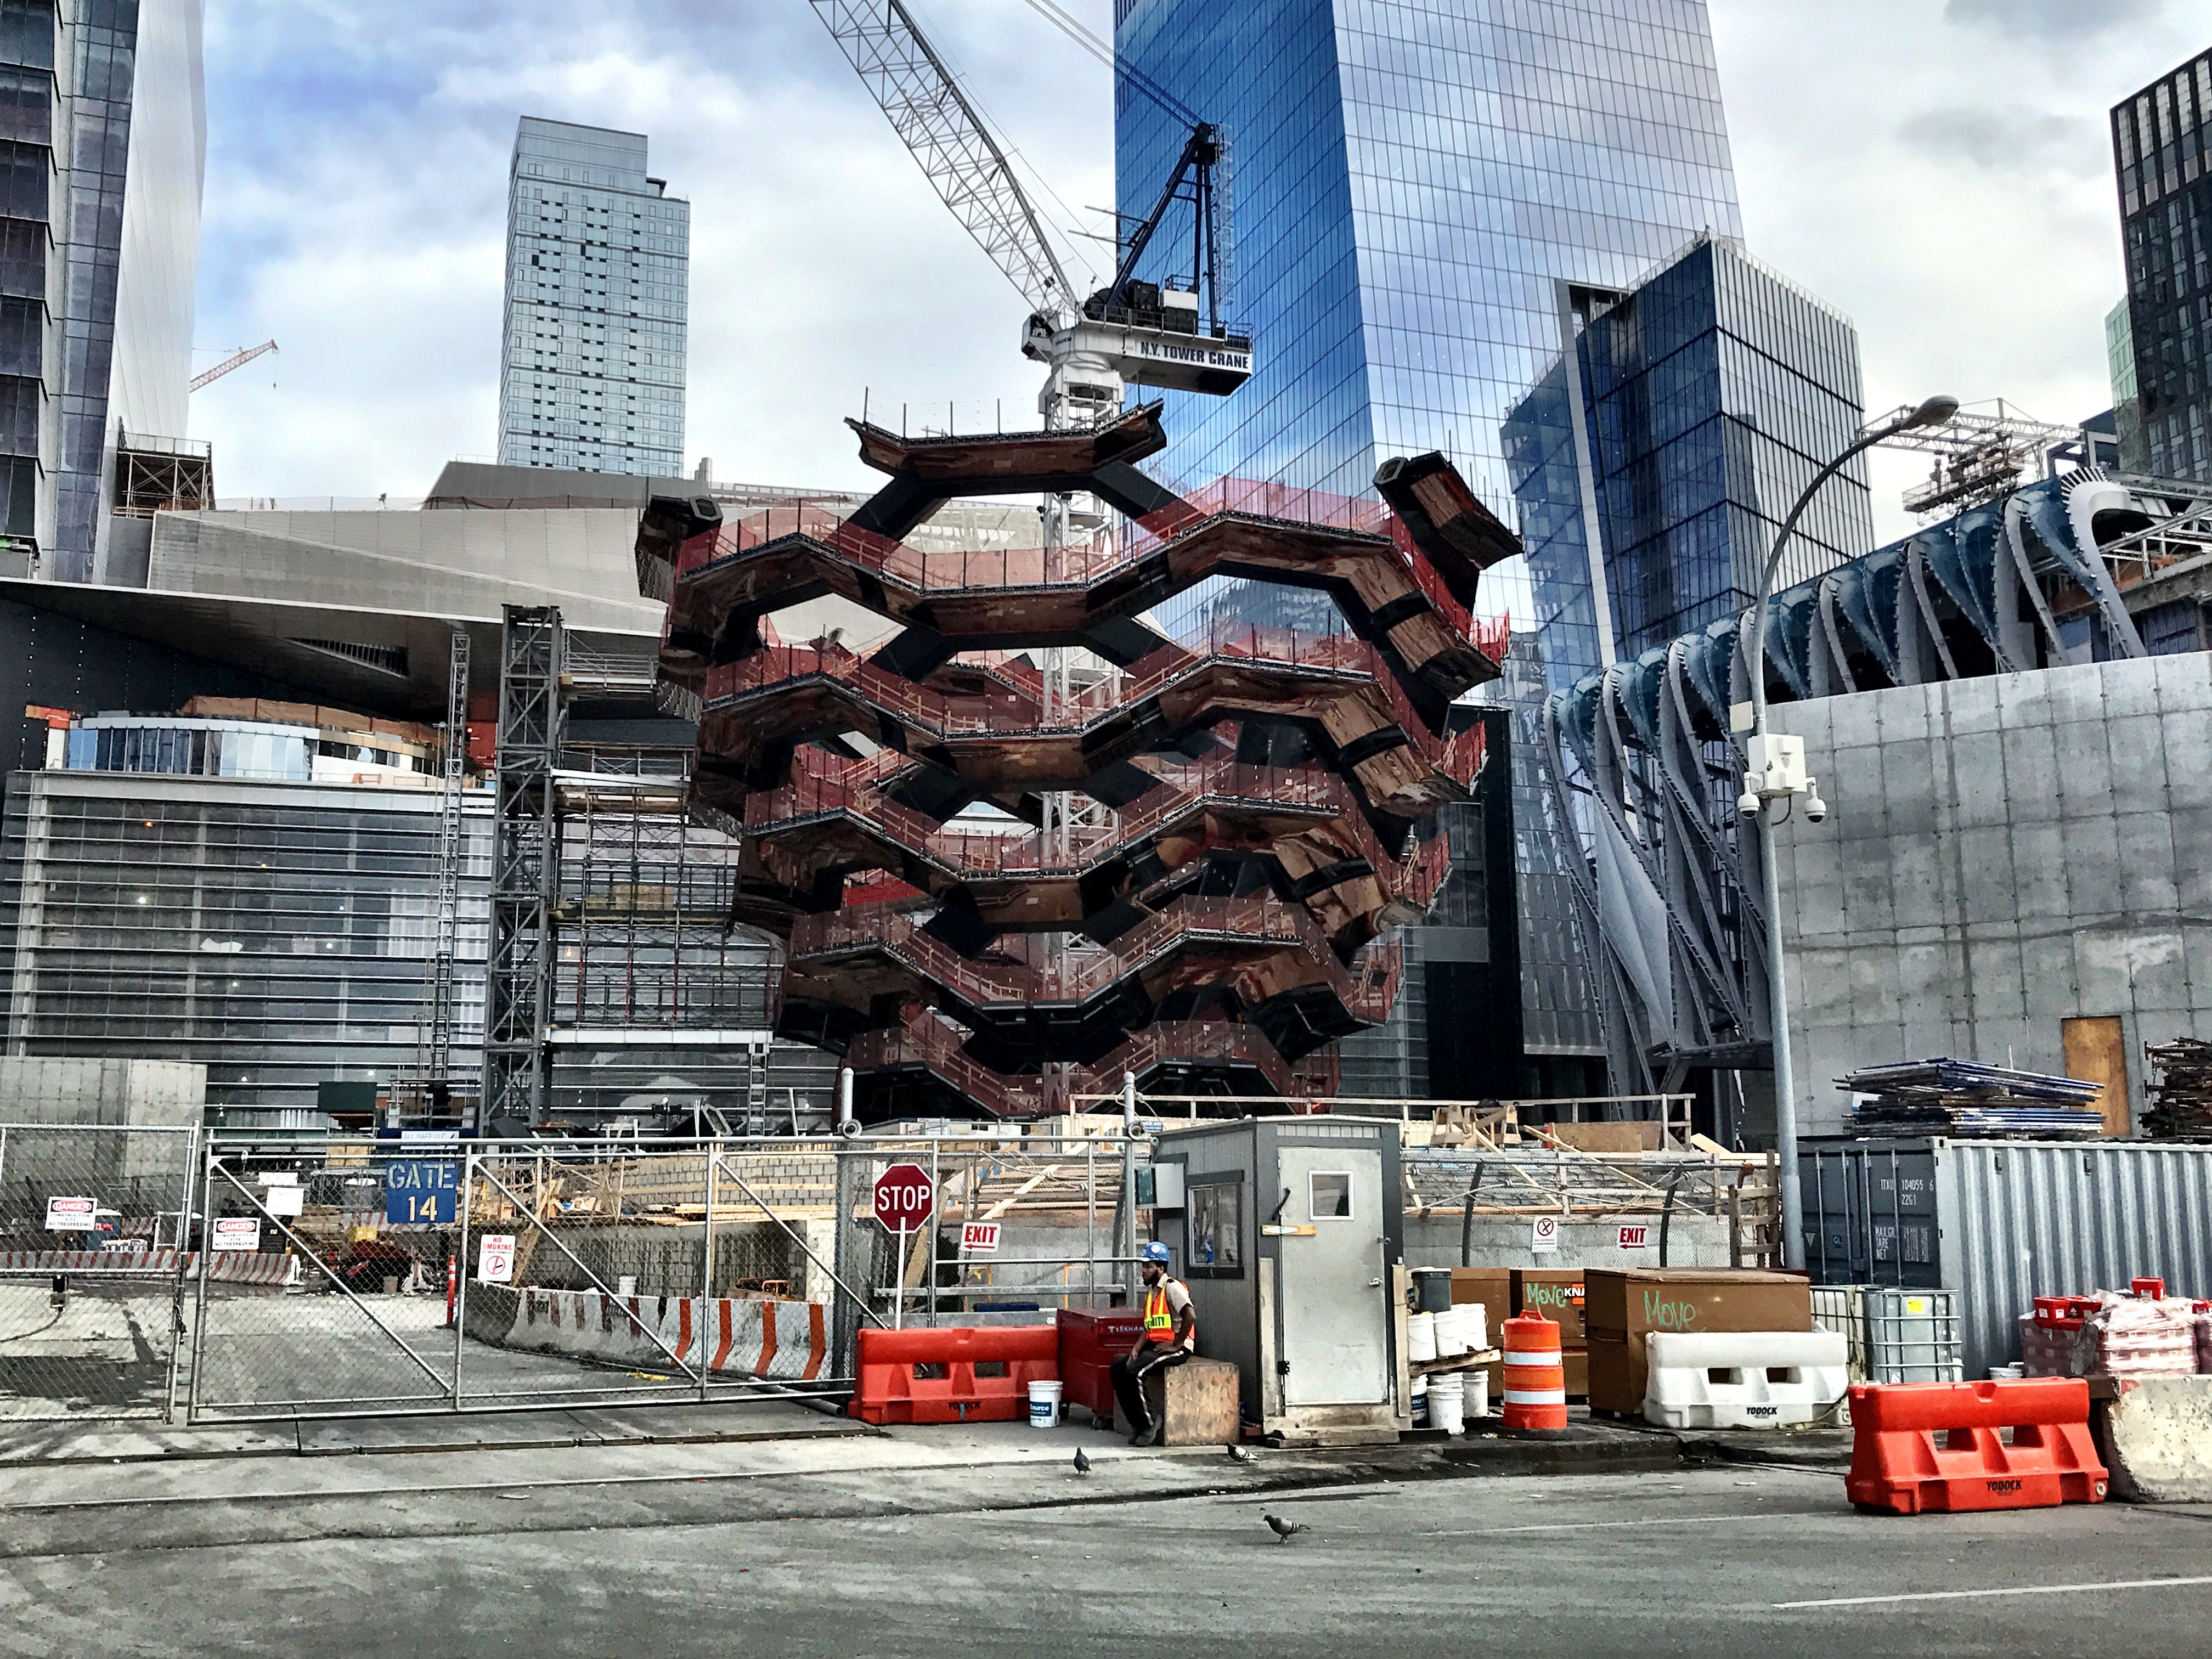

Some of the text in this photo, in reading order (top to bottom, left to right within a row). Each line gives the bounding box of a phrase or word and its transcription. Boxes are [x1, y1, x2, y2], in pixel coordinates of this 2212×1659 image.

[1141, 341, 1248, 369] N.Y. TOWER CRANE
[388, 1163, 455, 1189] GATE
[1901, 1180, 1923, 1190] 104055
[1929, 1180, 1934, 1191] 6
[55, 1202, 88, 1210] DANGER
[878, 1185, 930, 1211] STOP
[408, 1195, 437, 1221] 14
[964, 1225, 997, 1243] EXIT
[1620, 1227, 1646, 1243] EXIT
[1876, 1238, 1889, 1249] TARE
[1527, 1282, 1566, 1309] Move
[1644, 1290, 1706, 1331] Move
[1746, 1407, 1778, 1415] YODOCK
[1987, 1480, 2022, 1492] YODOCK
